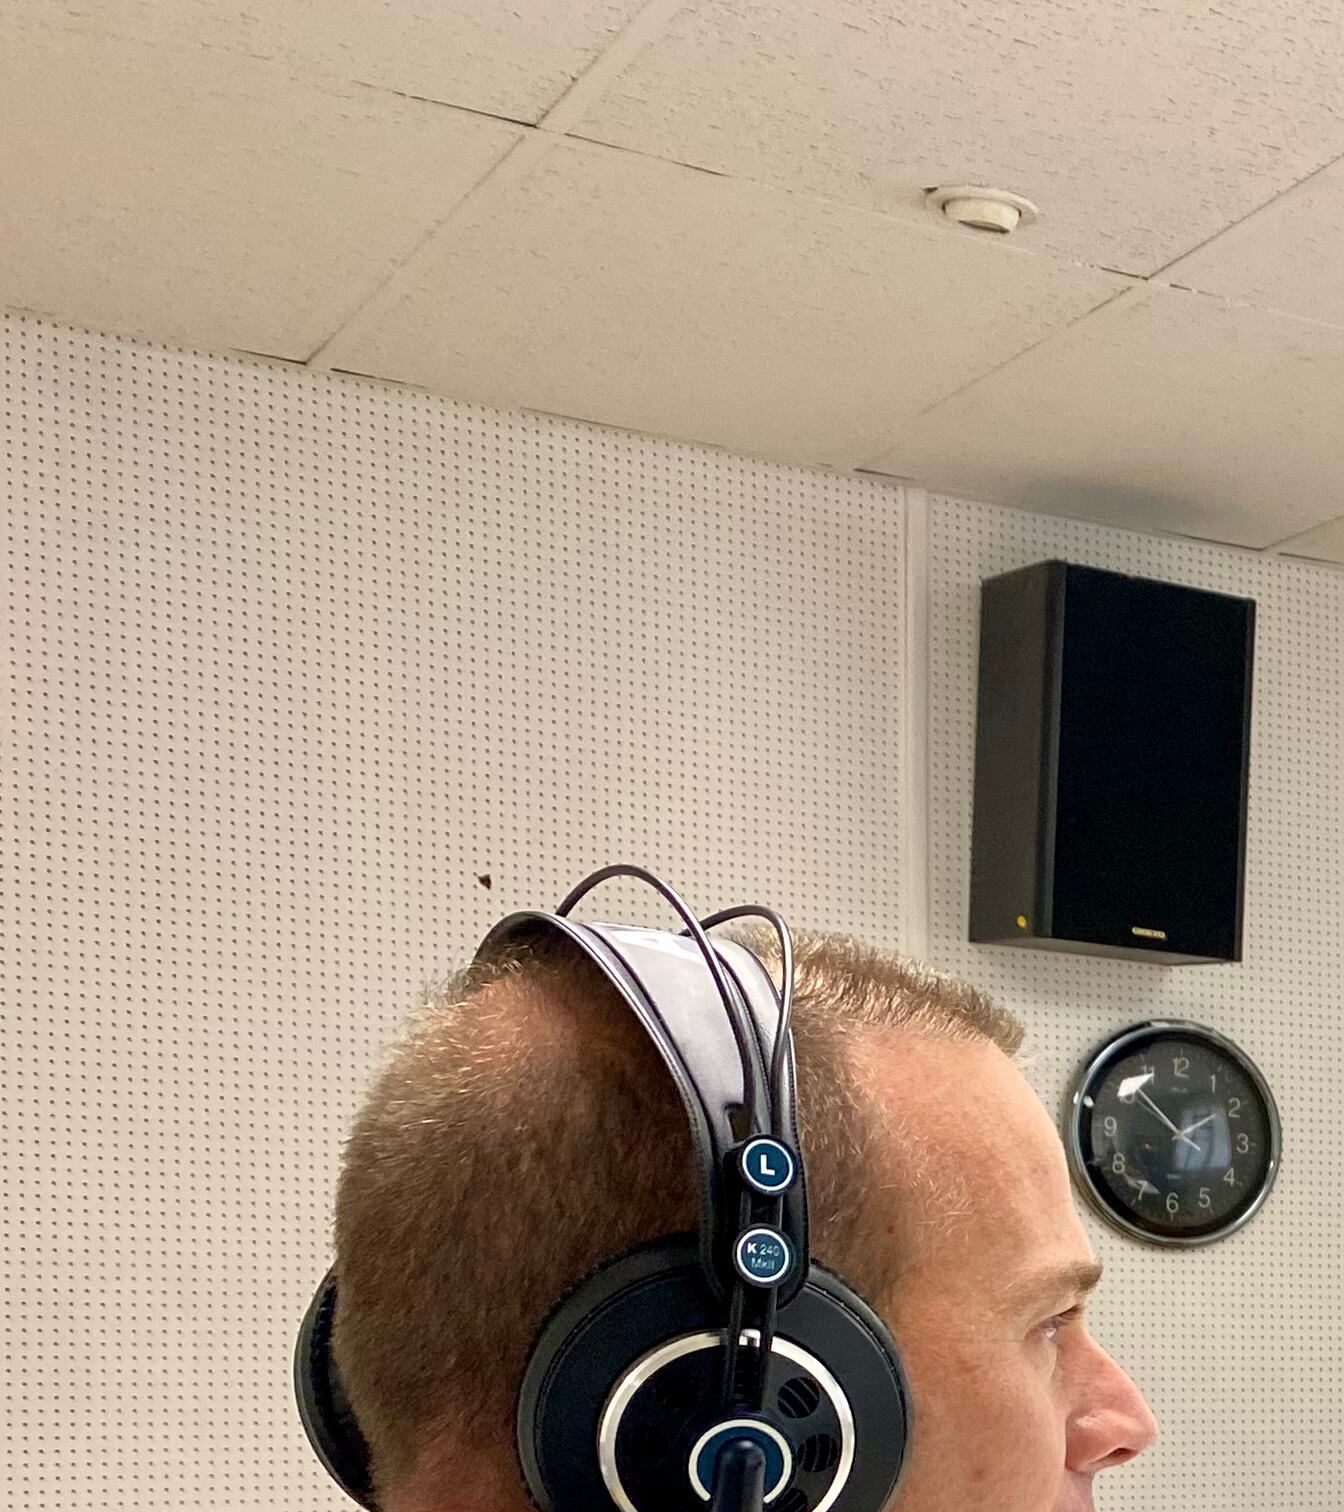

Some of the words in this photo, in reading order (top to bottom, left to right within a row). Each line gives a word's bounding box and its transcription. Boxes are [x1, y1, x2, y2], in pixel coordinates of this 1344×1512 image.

[1172, 1056, 1191, 1079] 12
[1209, 1074, 1217, 1094] 1
[1228, 1097, 1241, 1119] 2
[1103, 1116, 1118, 1138] 9
[1235, 1133, 1250, 1154] 3
[760, 1154, 776, 1176] L
[1111, 1152, 1126, 1174] 8
[1222, 1167, 1236, 1187] 4
[1135, 1180, 1149, 1201] 7
[1198, 1187, 1212, 1209] 5
[1165, 1192, 1180, 1214] 6
[747, 1242, 758, 1255] K
